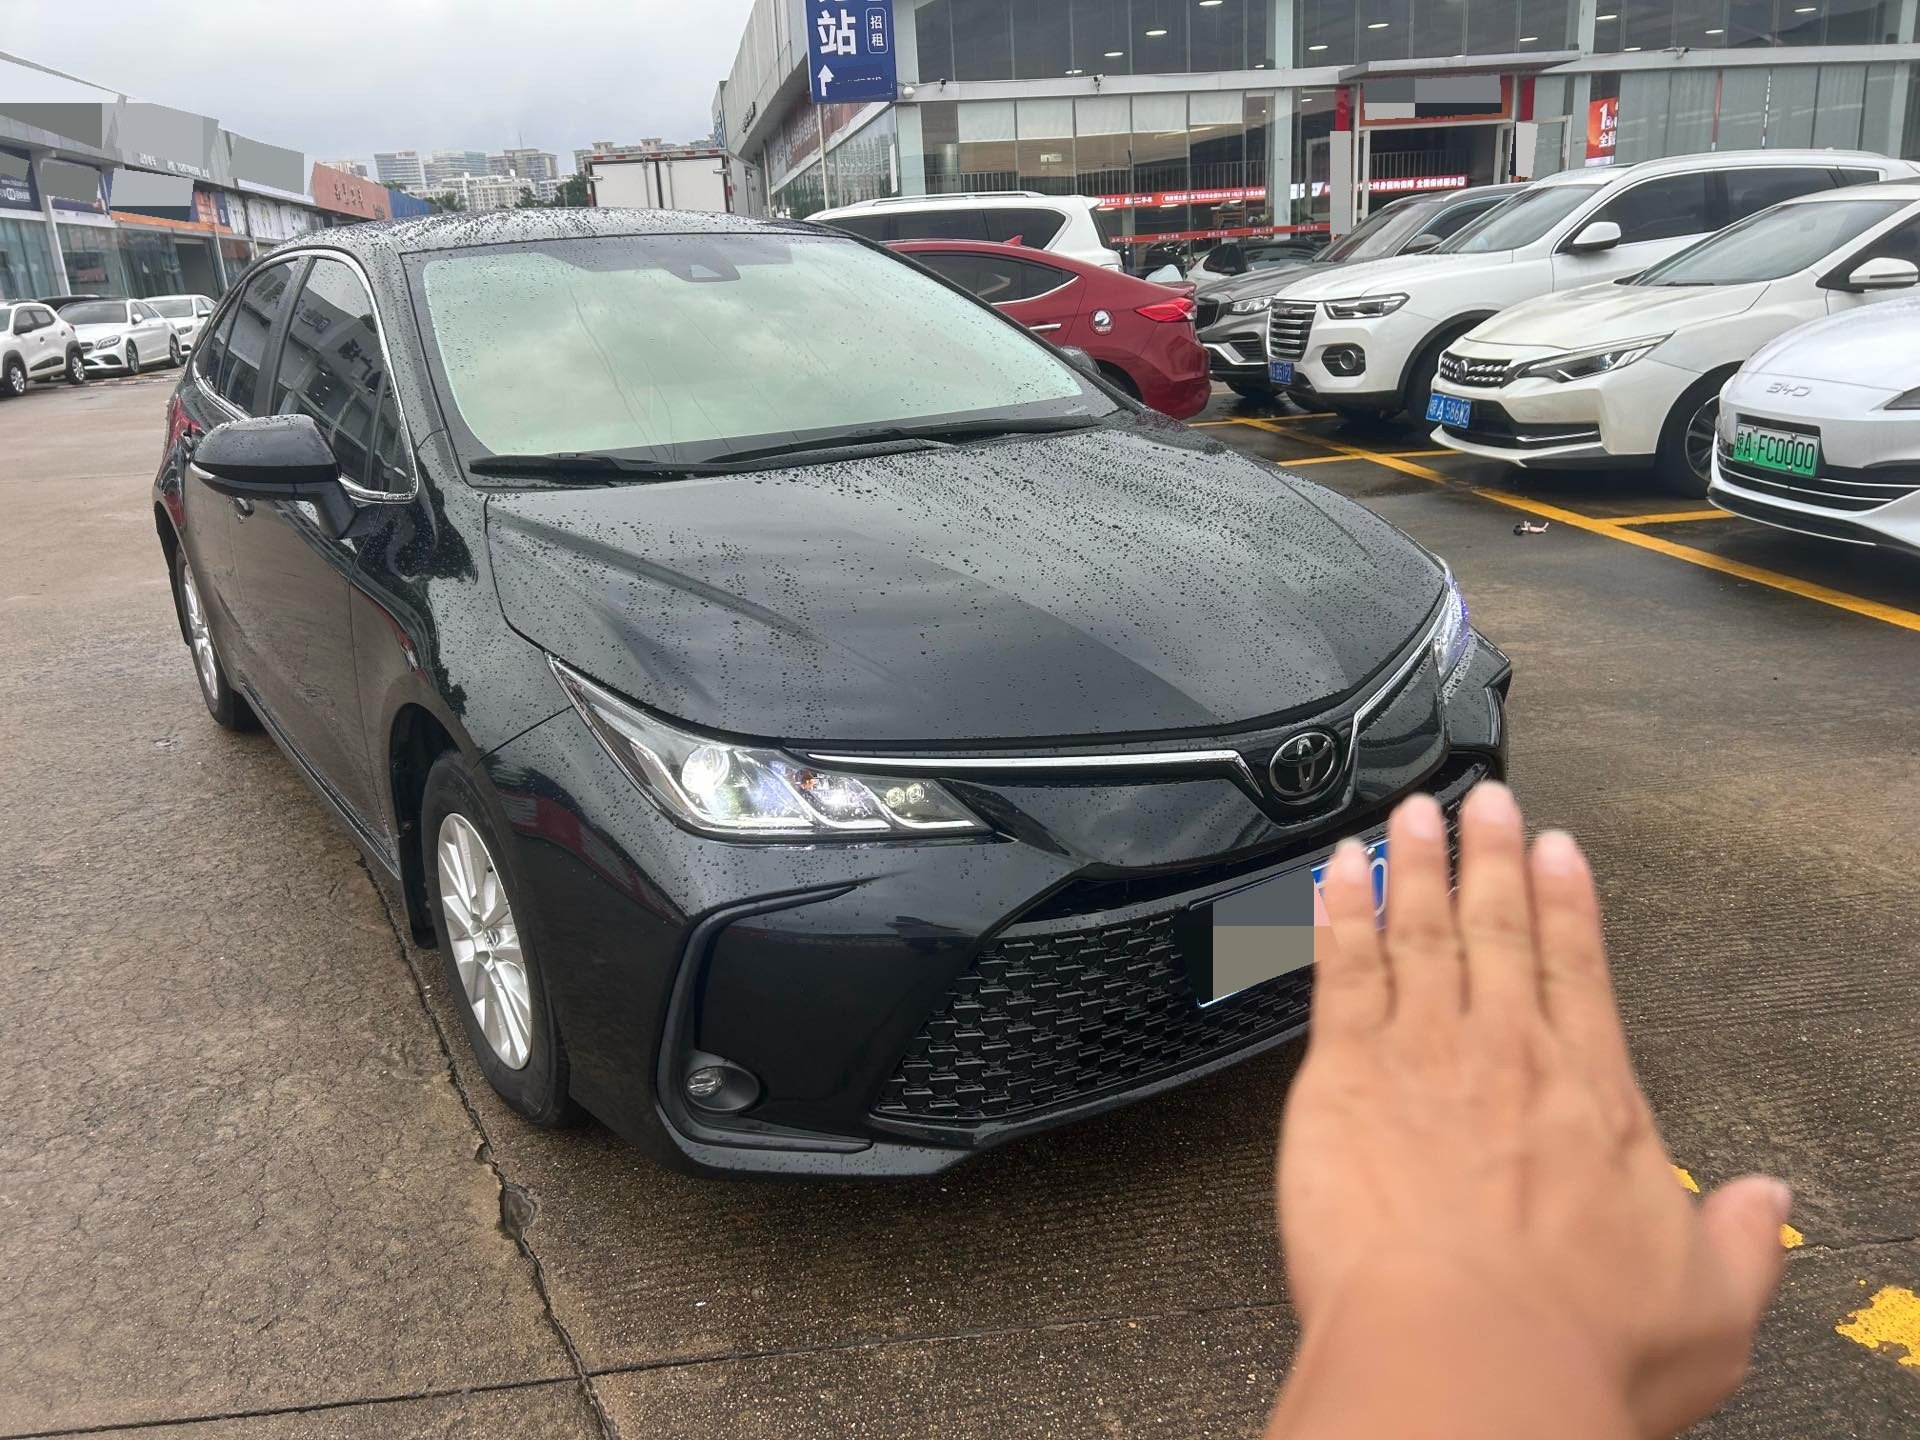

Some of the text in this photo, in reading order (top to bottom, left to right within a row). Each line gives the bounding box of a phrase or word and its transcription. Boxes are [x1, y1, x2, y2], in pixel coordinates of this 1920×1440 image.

[817, 9, 857, 55] 站
[870, 15, 884, 47] 招租
[1766, 383, 1811, 397] BYD
